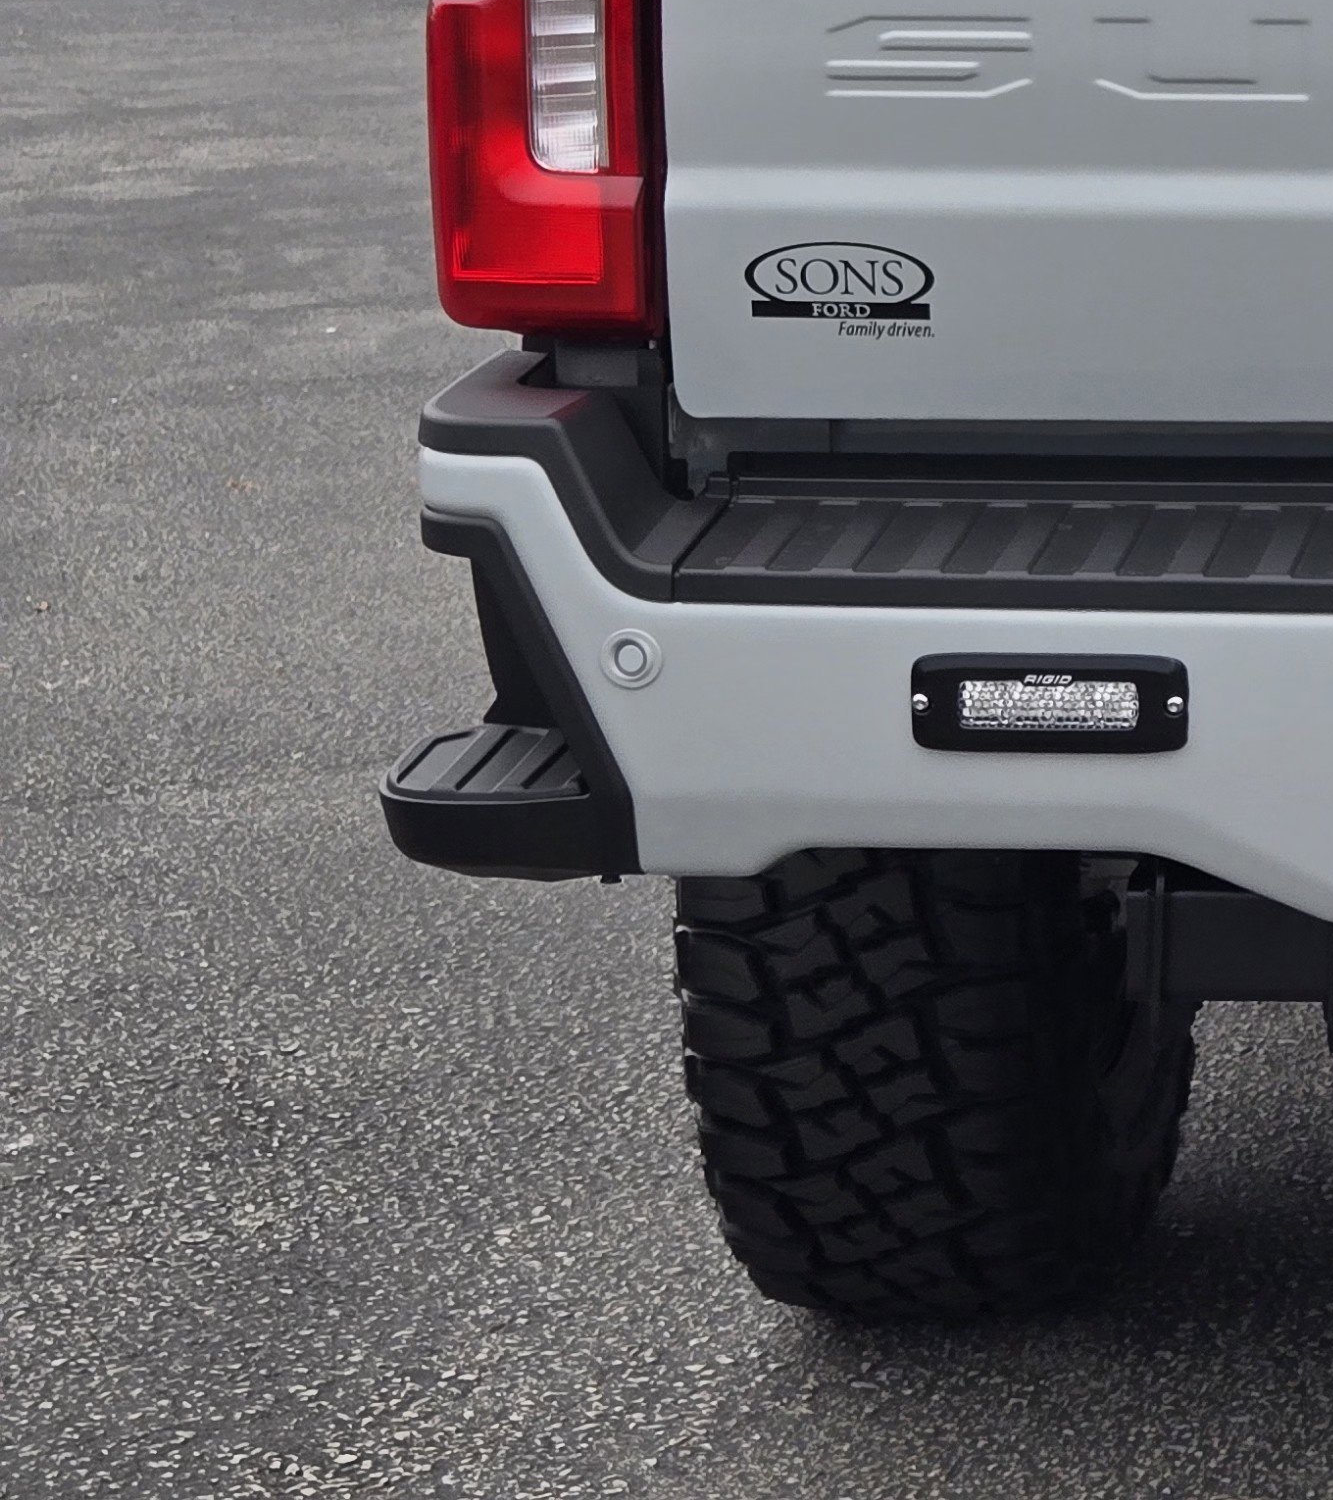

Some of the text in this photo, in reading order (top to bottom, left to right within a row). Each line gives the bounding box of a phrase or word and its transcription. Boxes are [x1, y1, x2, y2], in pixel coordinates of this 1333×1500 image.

[775, 257, 904, 297] SONS
[811, 303, 871, 318] FORD
[838, 321, 935, 340] Family driven.
[1023, 675, 1073, 685] RIGID
